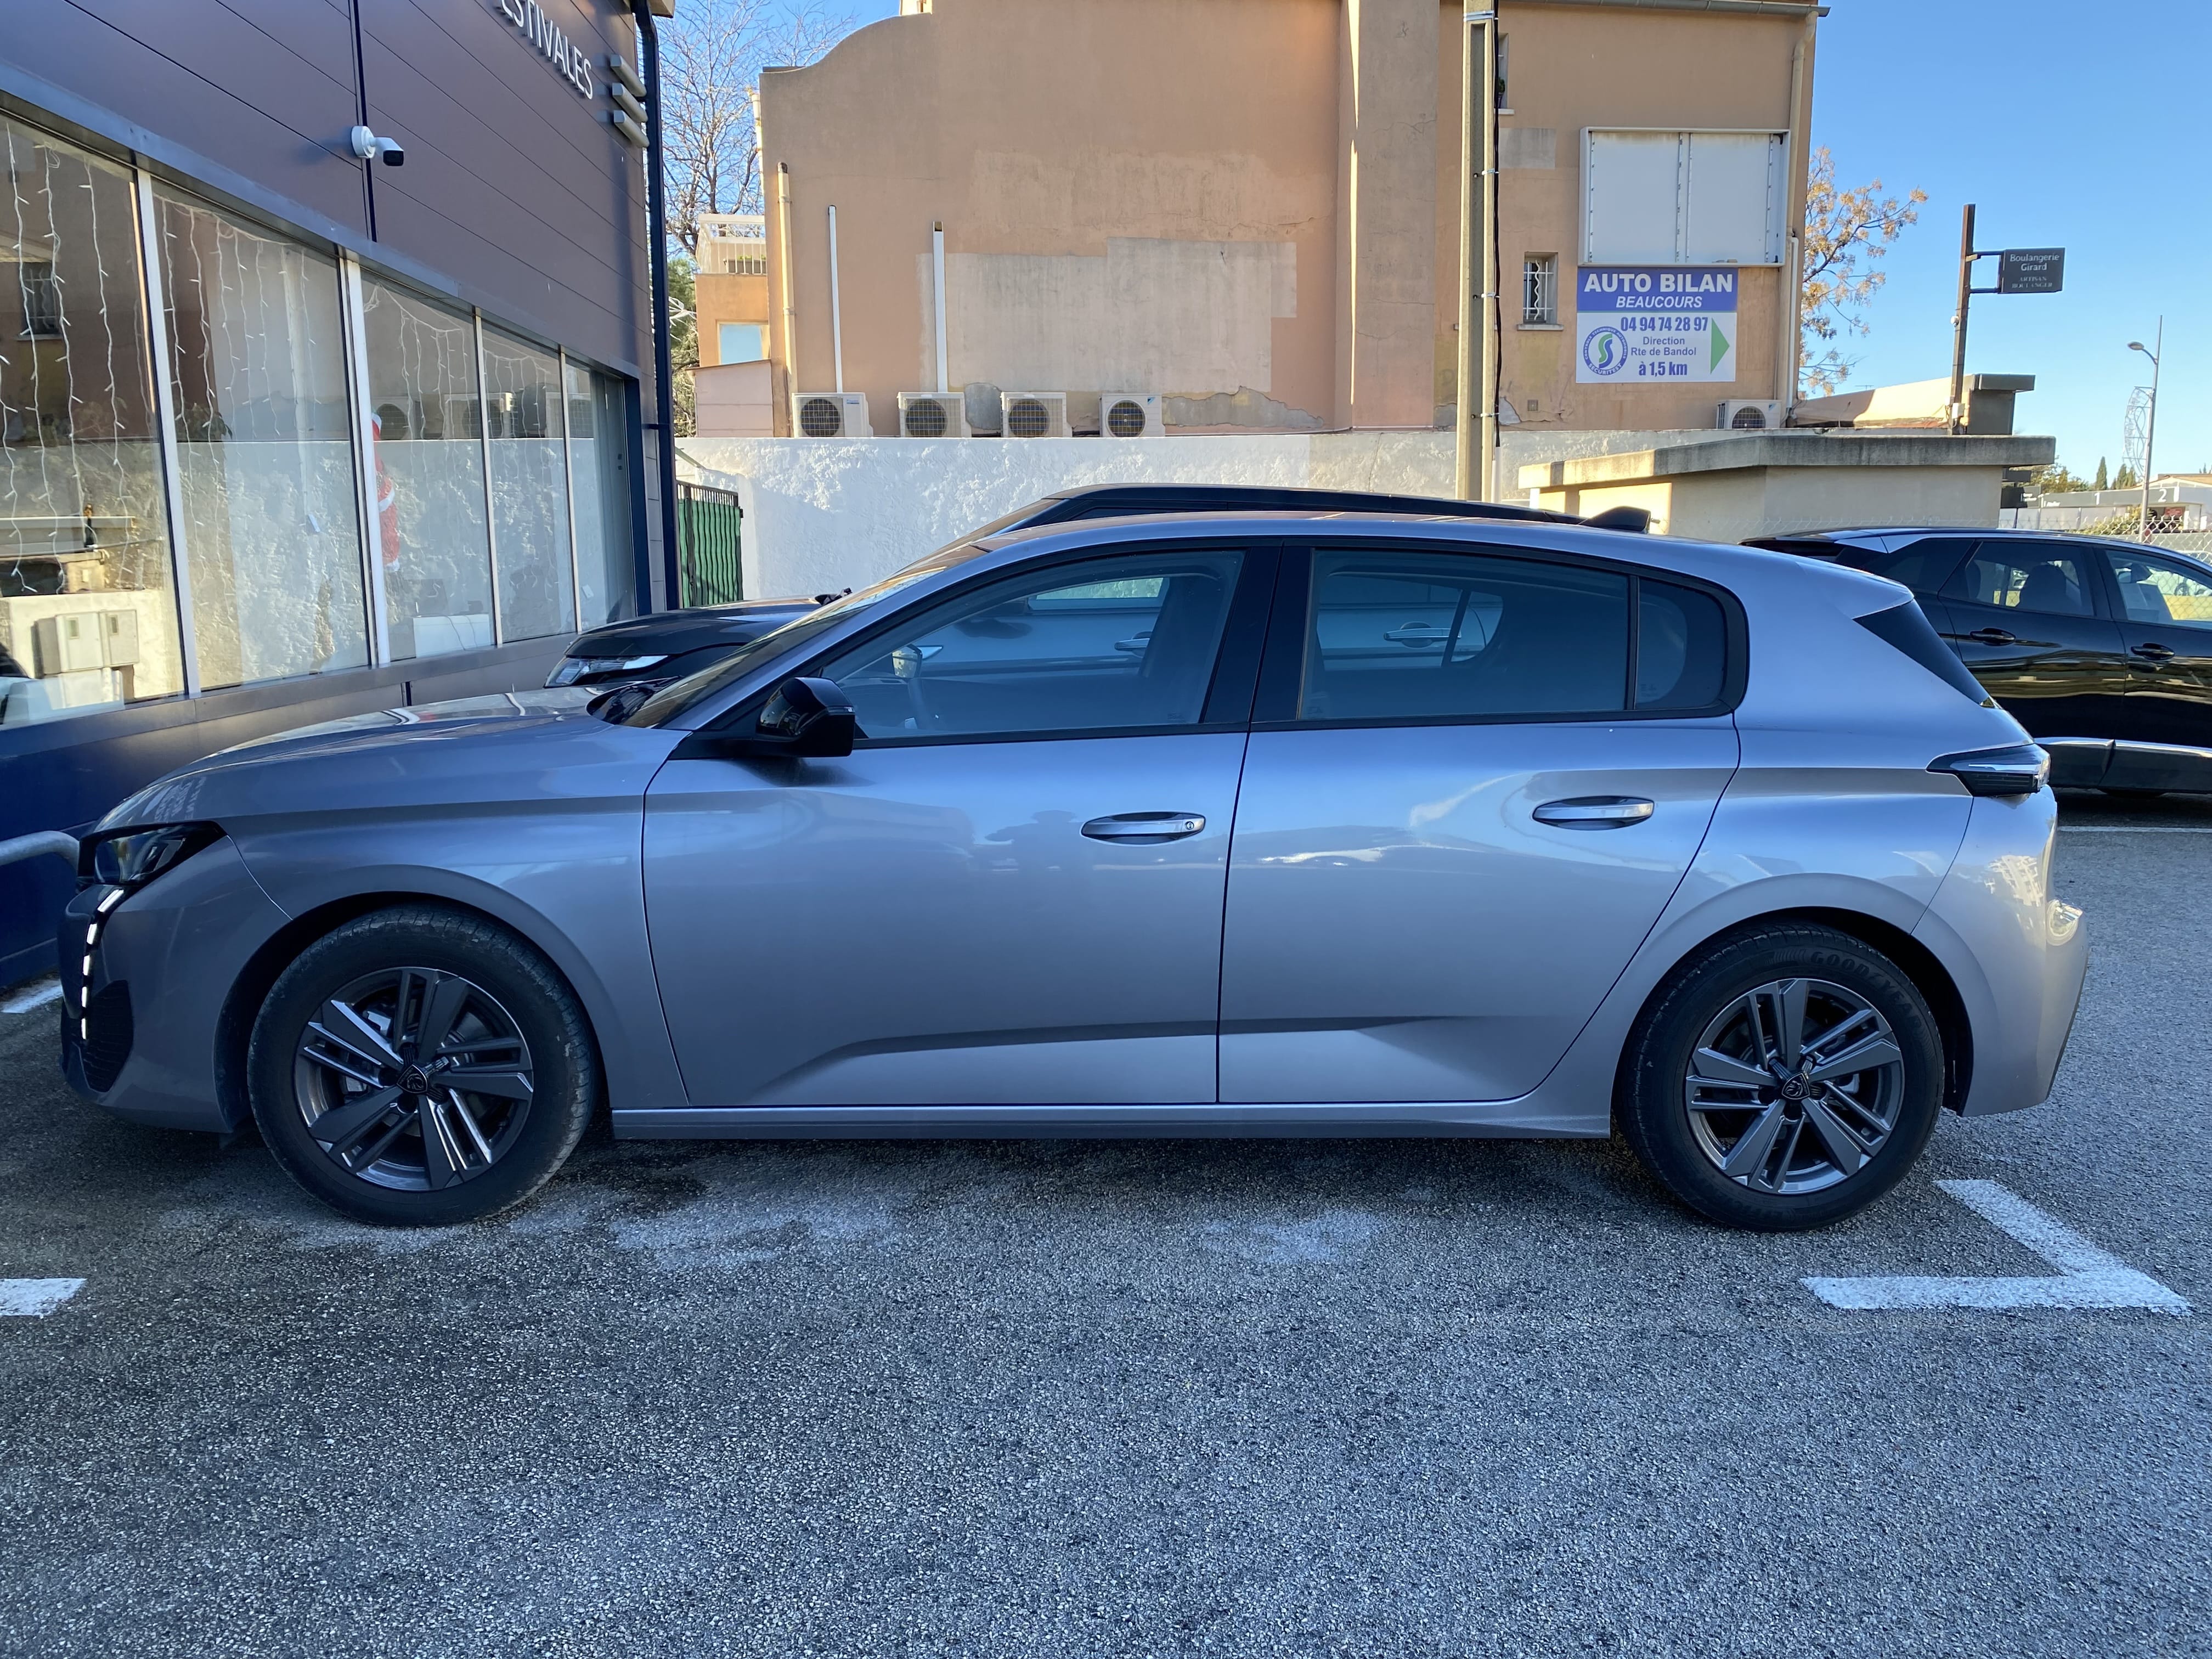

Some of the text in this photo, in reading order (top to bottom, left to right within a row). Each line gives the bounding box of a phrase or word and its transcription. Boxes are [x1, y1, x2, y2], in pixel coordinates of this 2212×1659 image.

[2010, 253, 2059, 262] Boulangerie
[1584, 273, 1733, 292] AUTO BILAN
[1616, 296, 1702, 308] BEAUCOURS
[1621, 317, 1708, 331] 04 94 74 28 97
[1643, 336, 1685, 345] Direction
[1631, 347, 1696, 356] Rte de Bandol
[1588, 362, 1622, 375] SECURITEST
[1639, 362, 1688, 377] à 1,5 km
[2094, 492, 2101, 505] 1
[2158, 488, 2168, 503] 2
[1811, 951, 1922, 1029] GOODYEAR
